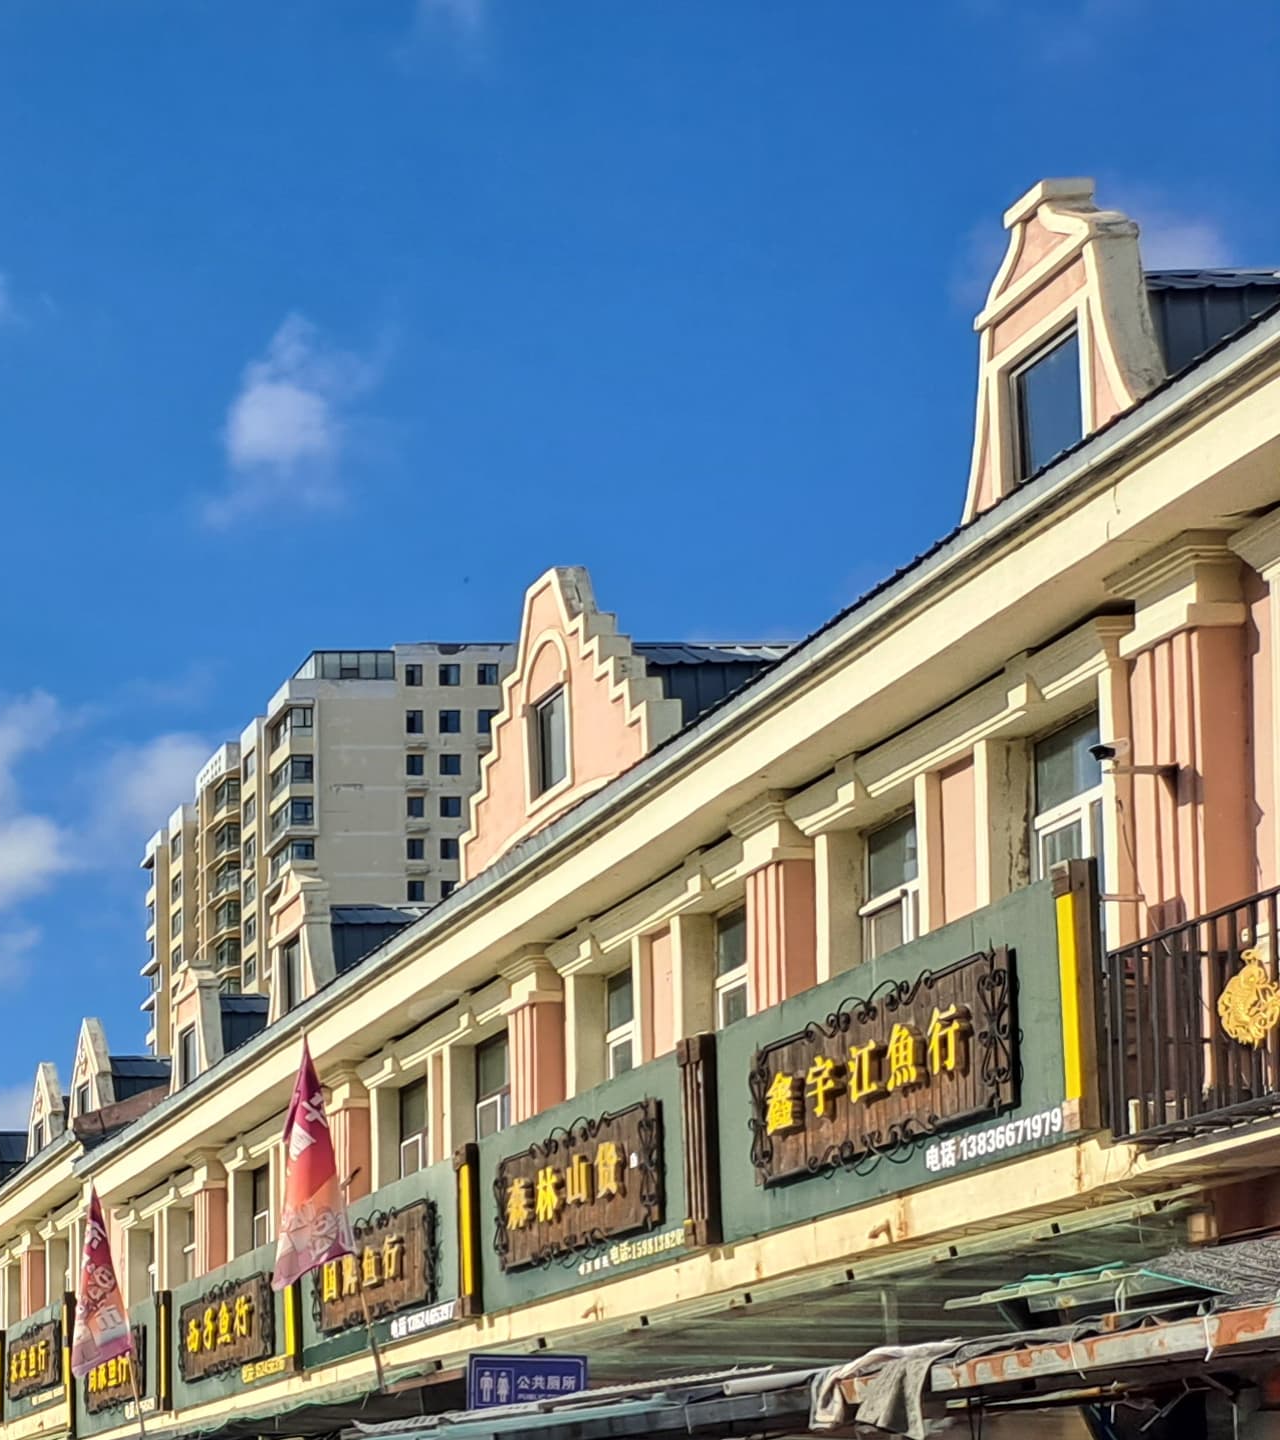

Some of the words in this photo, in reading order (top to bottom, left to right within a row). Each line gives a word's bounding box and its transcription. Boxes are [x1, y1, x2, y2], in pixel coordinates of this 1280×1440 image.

[766, 1003, 961, 1136] 鑫宇江魚行
[925, 1139, 956, 1172] 电话
[959, 1107, 1062, 1161] 13836671979
[506, 1141, 620, 1230] 森林山货
[517, 1374, 577, 1391] 公共厕所
